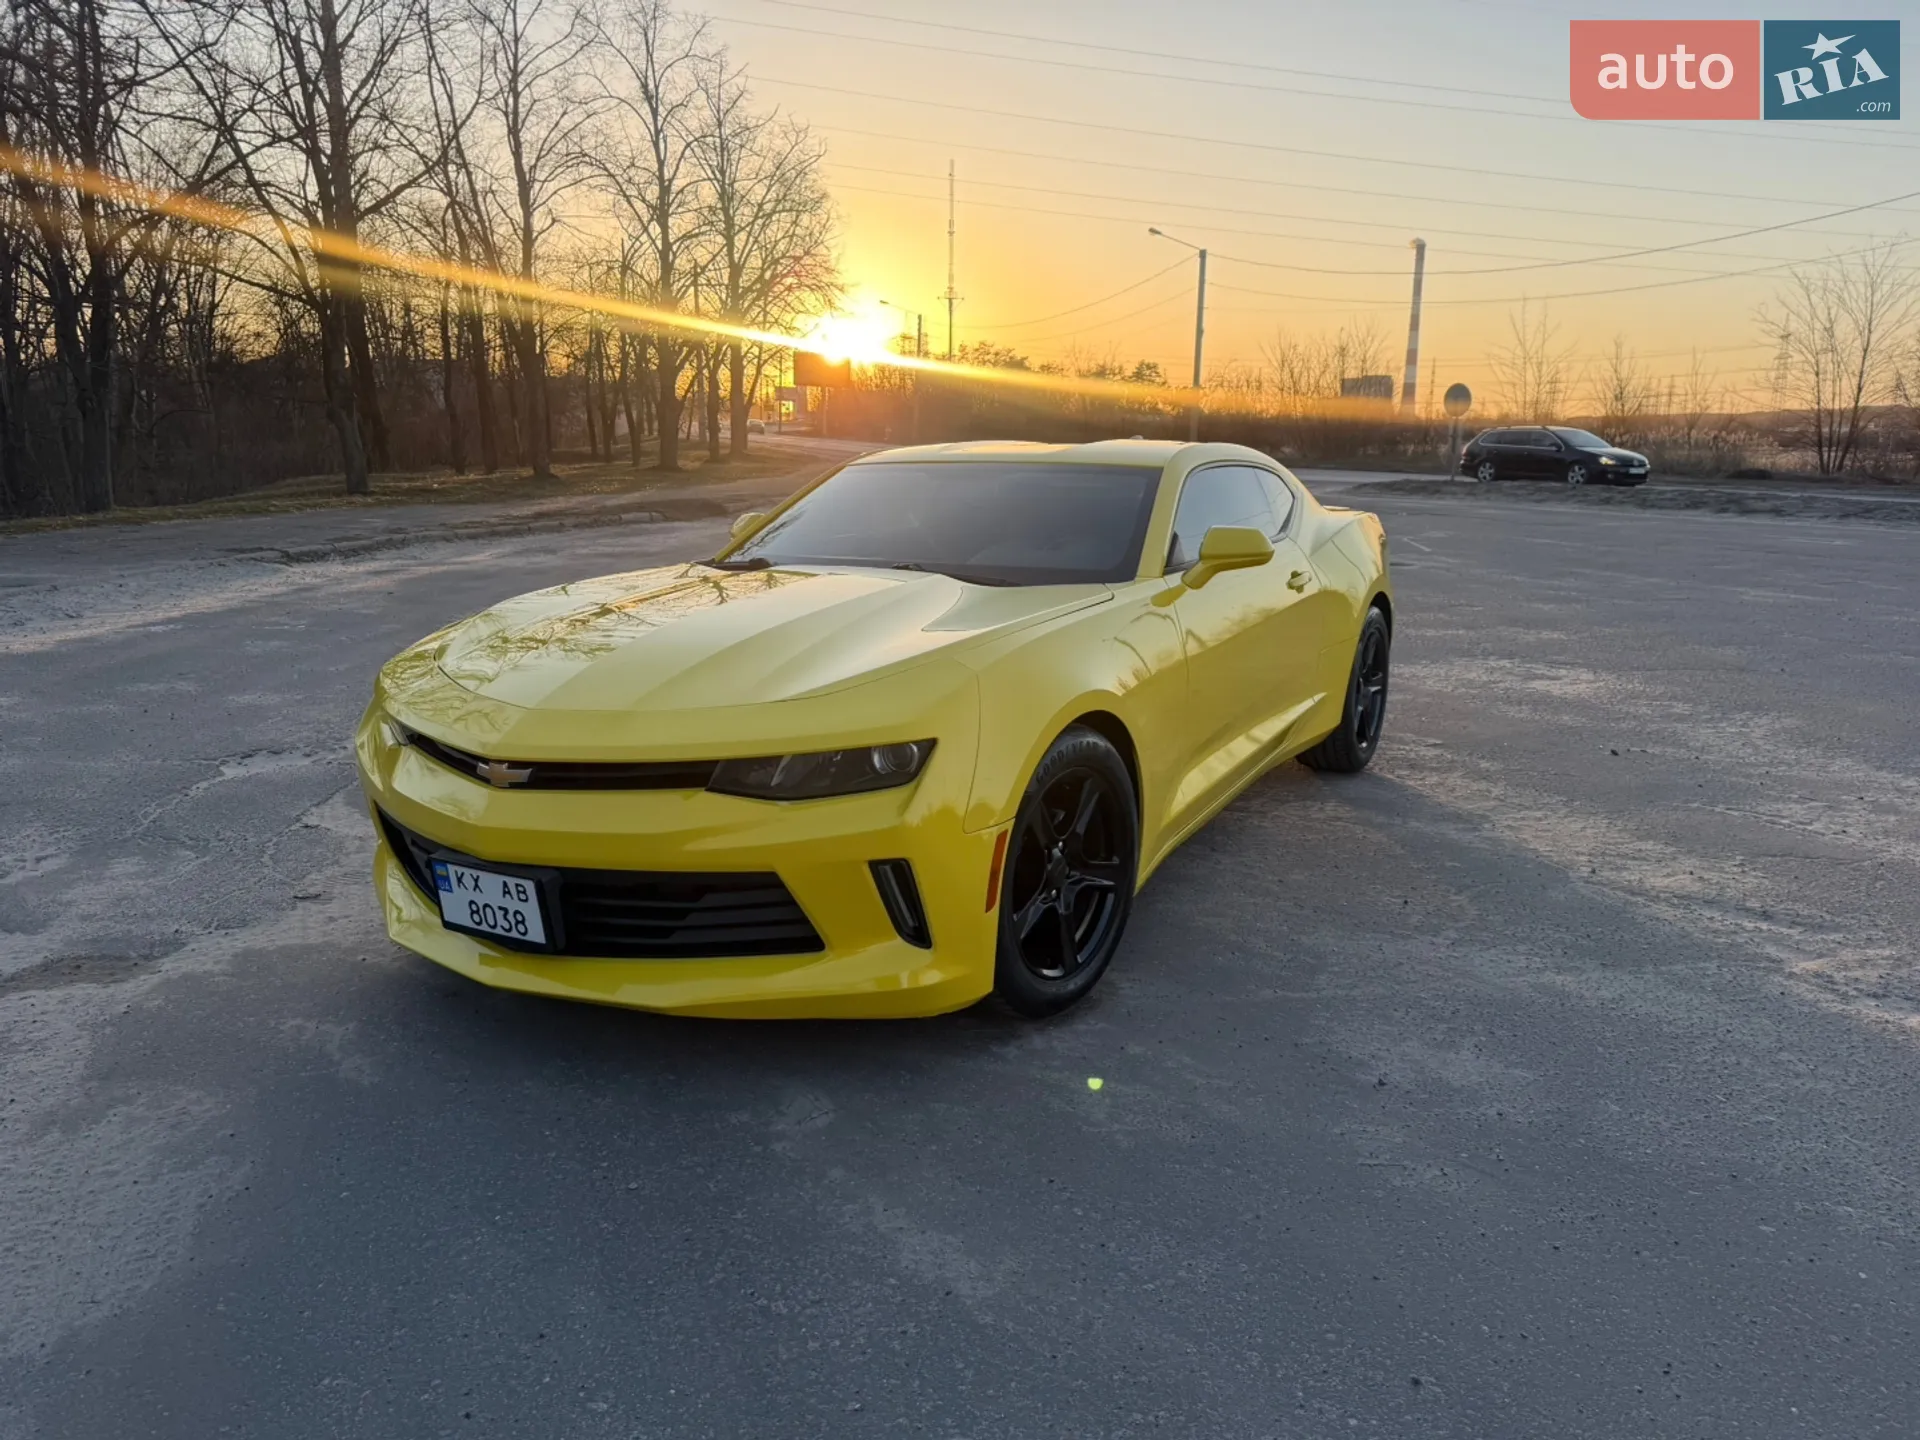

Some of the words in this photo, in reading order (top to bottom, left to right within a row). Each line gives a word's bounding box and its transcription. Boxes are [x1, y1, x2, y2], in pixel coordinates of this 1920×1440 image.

[455, 869, 483, 894] KX
[502, 880, 529, 903] AB
[468, 899, 528, 937] 8038
